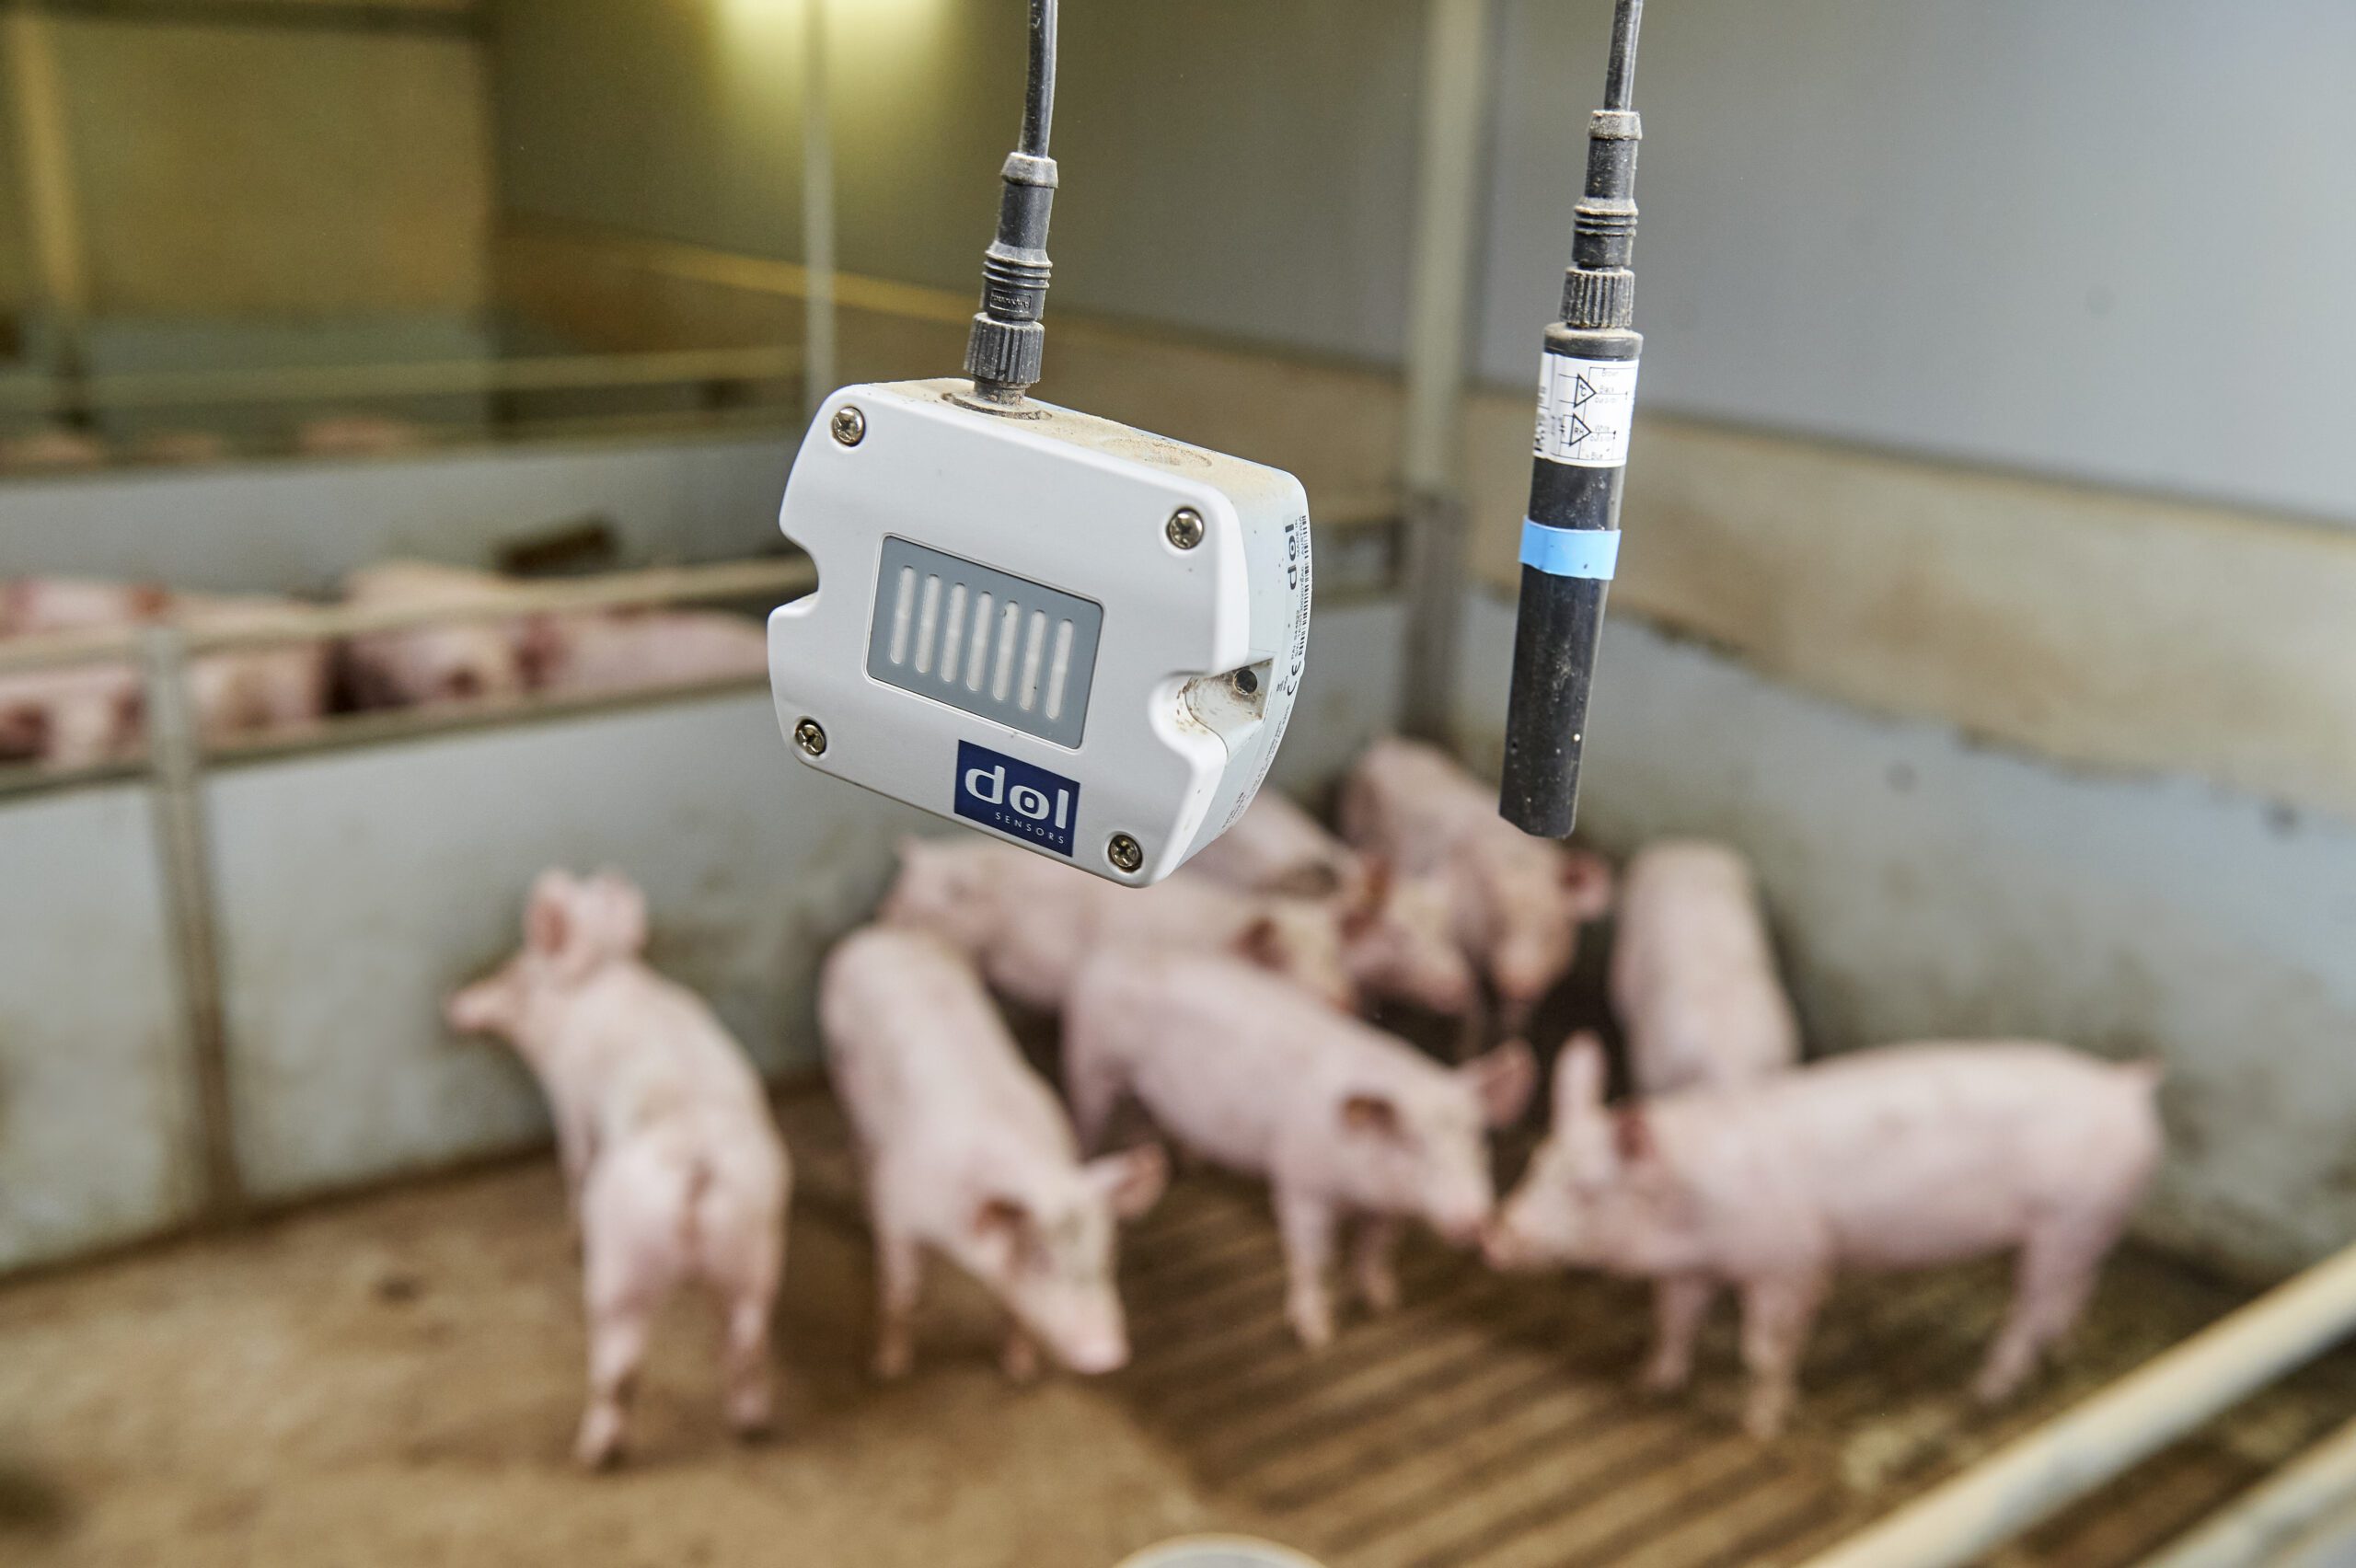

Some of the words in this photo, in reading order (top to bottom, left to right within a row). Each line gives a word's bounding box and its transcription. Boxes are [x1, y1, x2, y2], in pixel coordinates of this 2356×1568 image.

[1285, 524, 1297, 590] dol
[965, 765, 1069, 829] dol
[996, 812, 1064, 844] SENSORS
